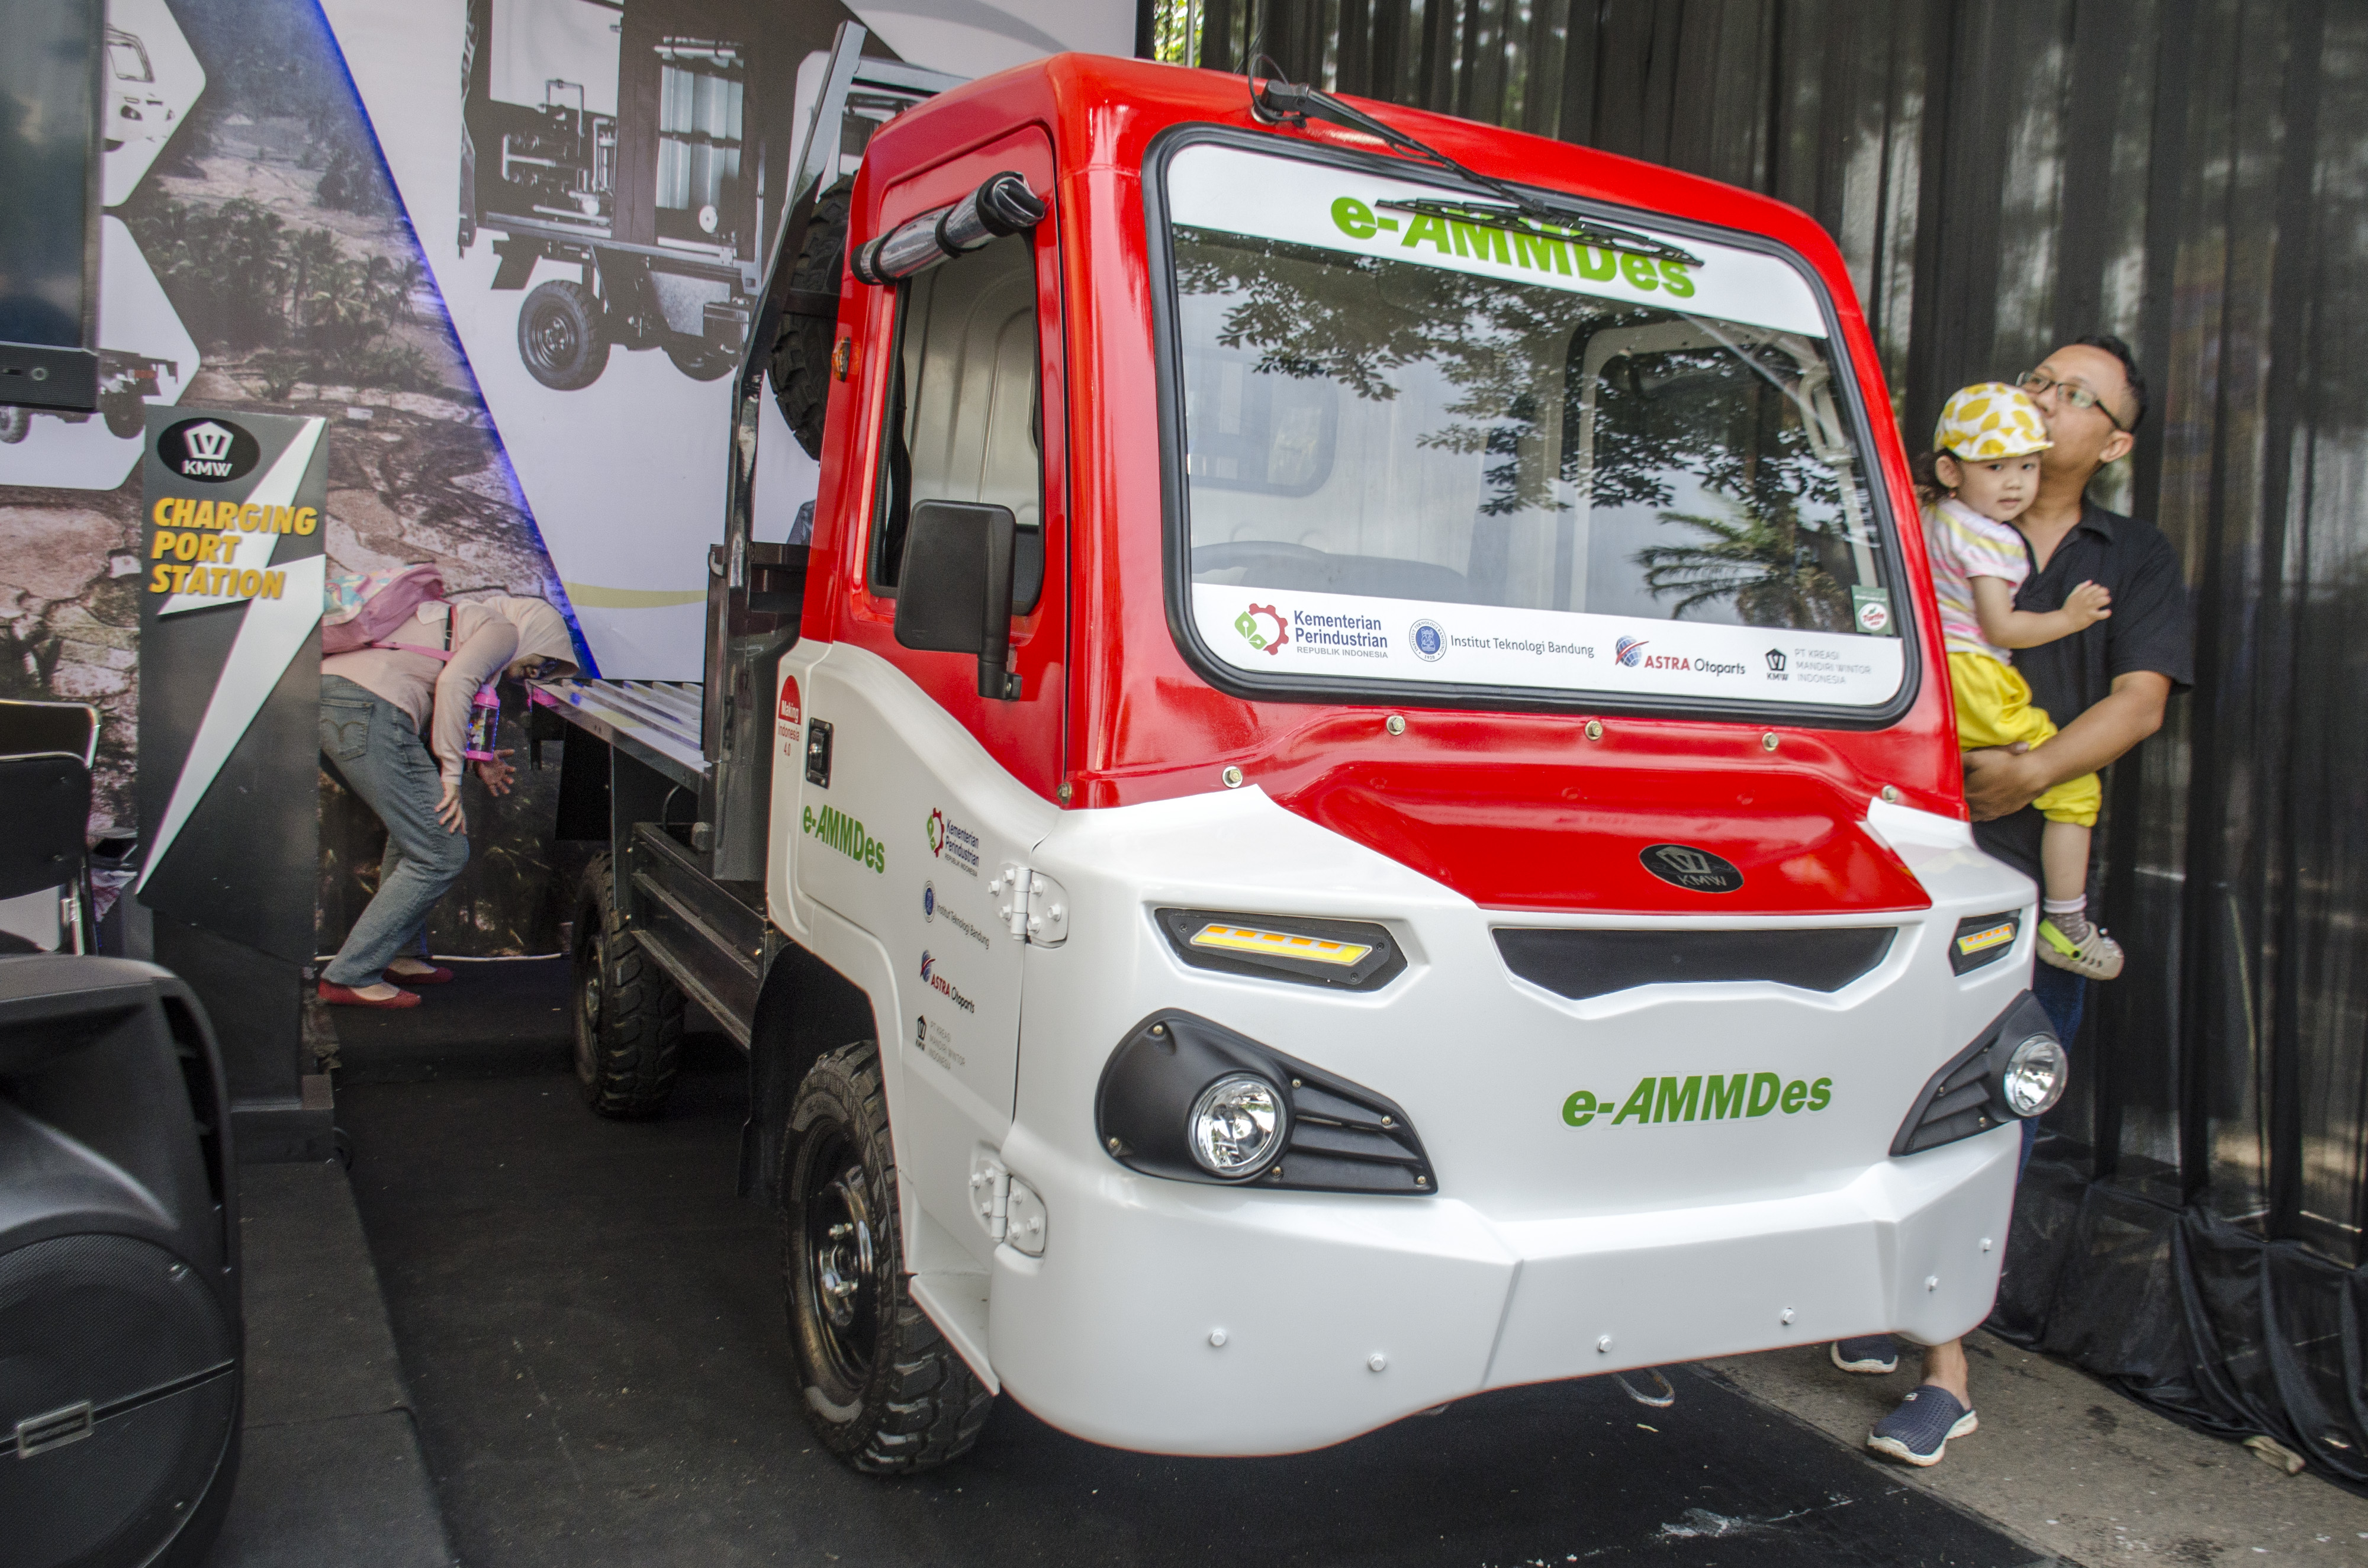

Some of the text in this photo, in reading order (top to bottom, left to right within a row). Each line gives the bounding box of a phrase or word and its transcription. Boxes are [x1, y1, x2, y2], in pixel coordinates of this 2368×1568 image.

[1331, 197, 1695, 299] e-AMMDes
[182, 460, 233, 476] KMW
[153, 498, 318, 535] CHARGING
[151, 531, 241, 563] PORT
[149, 564, 285, 598] STATION
[1294, 610, 1382, 631] Kementerian
[1295, 627, 1388, 648] Perindustrian
[1450, 635, 1594, 658] Institut Teknologi Bandung
[1297, 646, 1388, 659] REPUBLIK INDONESIA
[1795, 649, 1839, 660] PT KREASI
[1644, 655, 1745, 677] ASTRA Otoparts
[1767, 672, 1789, 681] KMW
[1796, 662, 1871, 674] MANDIRI WINTOR
[1798, 674, 1846, 684] INDONESIA
[781, 700, 799, 723] Making
[778, 721, 799, 741] Indonesia
[803, 804, 885, 874] e-AMMDes
[947, 819, 979, 849] Kementerian
[945, 835, 979, 867] Perindustrian
[1677, 875, 1727, 886] KMW
[951, 910, 970, 935] Teknologi
[970, 925, 989, 949] Bandung
[931, 974, 974, 1013] ASTRA Otoparts
[1562, 1072, 1832, 1127] e-AMMDes
